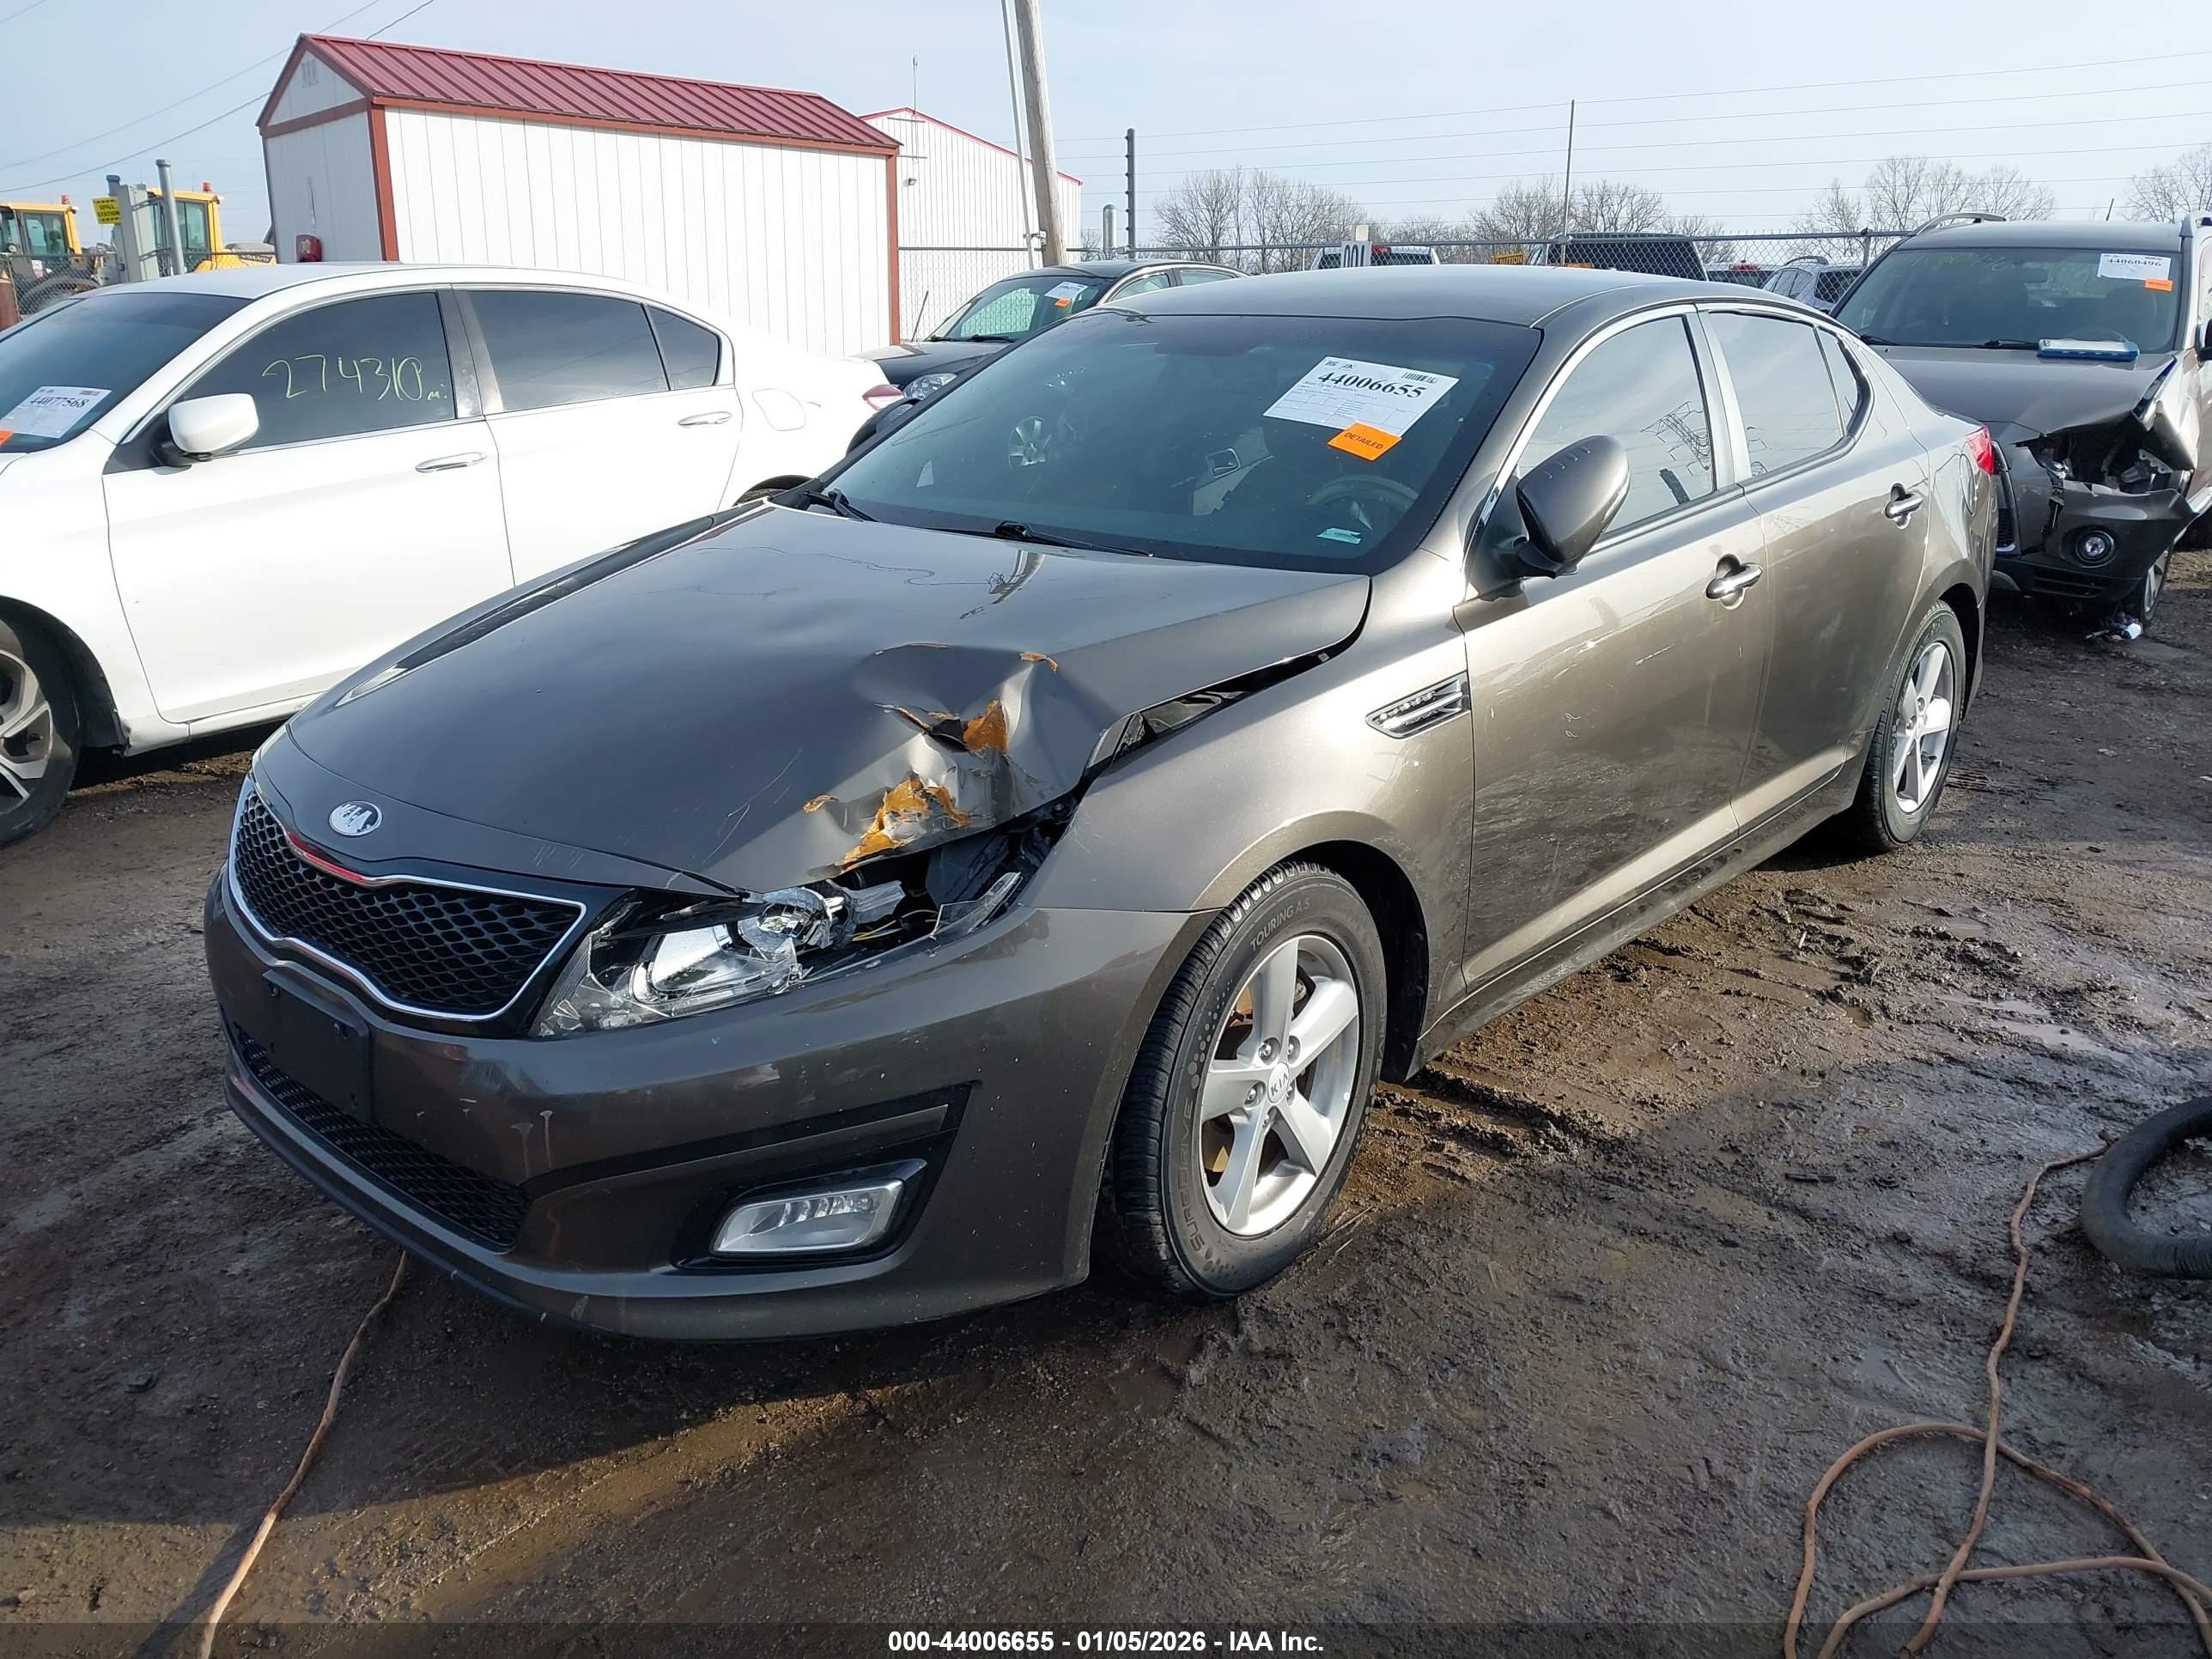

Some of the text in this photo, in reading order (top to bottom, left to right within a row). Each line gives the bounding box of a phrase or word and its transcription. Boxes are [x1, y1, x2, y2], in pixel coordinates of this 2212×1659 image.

[1494, 255, 1523, 265] CAUTION
[1317, 371, 1428, 400] 44006655
[29, 395, 90, 409] 44077568
[1343, 431, 1384, 451] DETAILED
[1250, 907, 1294, 952] TOURING
[1271, 1073, 1288, 1097] KIA
[1176, 1098, 1206, 1252] SUREDRIVE
